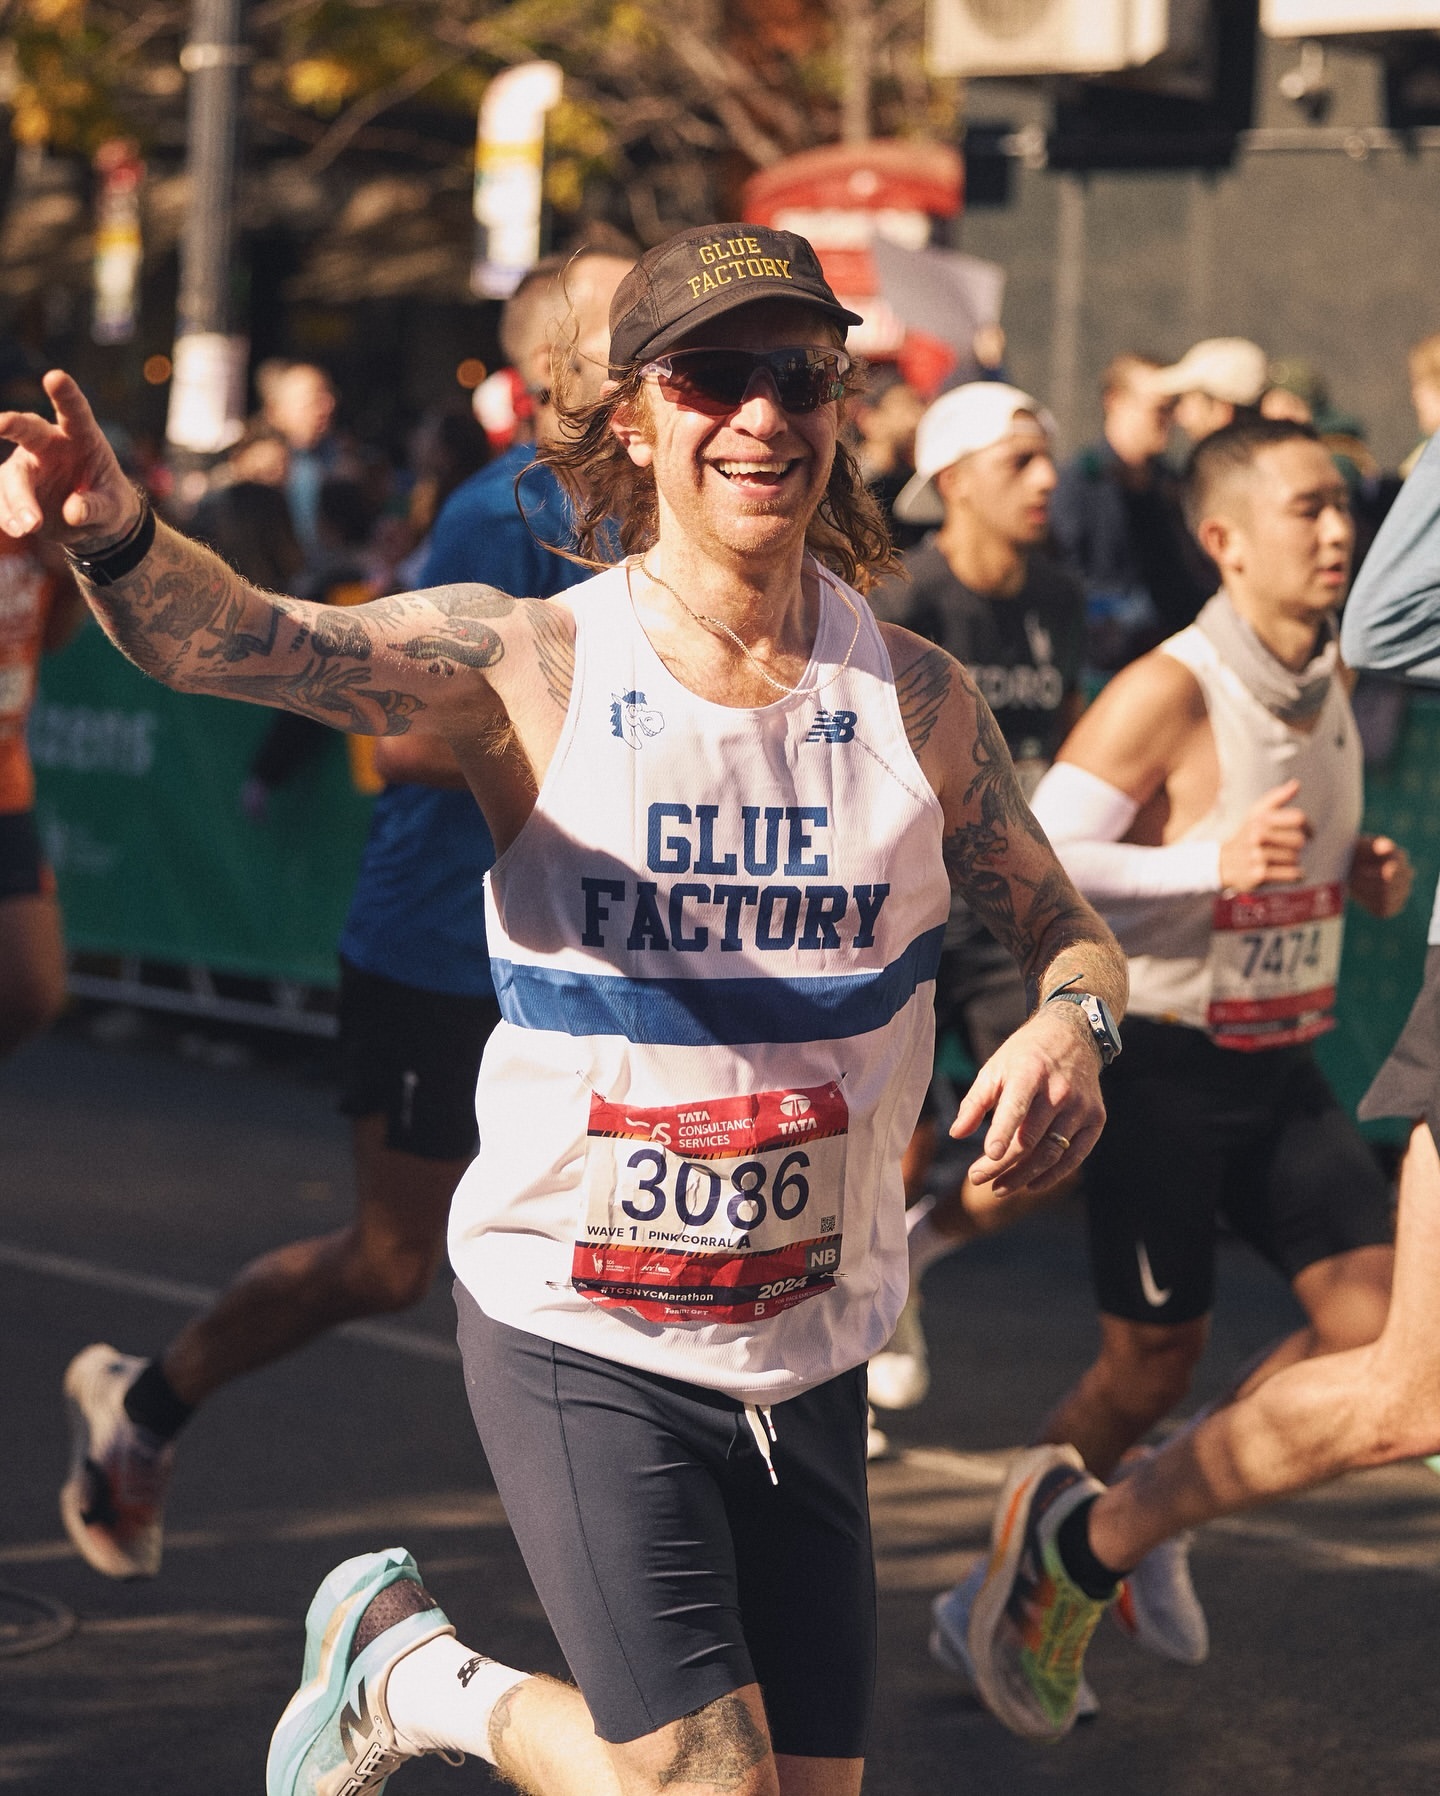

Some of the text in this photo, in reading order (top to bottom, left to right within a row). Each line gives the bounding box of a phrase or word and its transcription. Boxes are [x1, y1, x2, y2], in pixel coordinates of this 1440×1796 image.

[699, 237, 762, 265] GLUE
[687, 258, 793, 299] FACTORY
[646, 802, 829, 877] GLUE
[581, 877, 891, 952] FACTORY
[678, 1110, 711, 1124] TATA
[678, 1117, 757, 1138] CONSULTANCY
[778, 1117, 818, 1136] TATA
[678, 1134, 731, 1149] SERVICES
[621, 1148, 811, 1232] 3086
[587, 1225, 751, 1250] WAVE 1 PINK CORRAL A
[810, 1248, 837, 1268] NB
[757, 1275, 809, 1300] 2024
[754, 1302, 765, 1316] B
